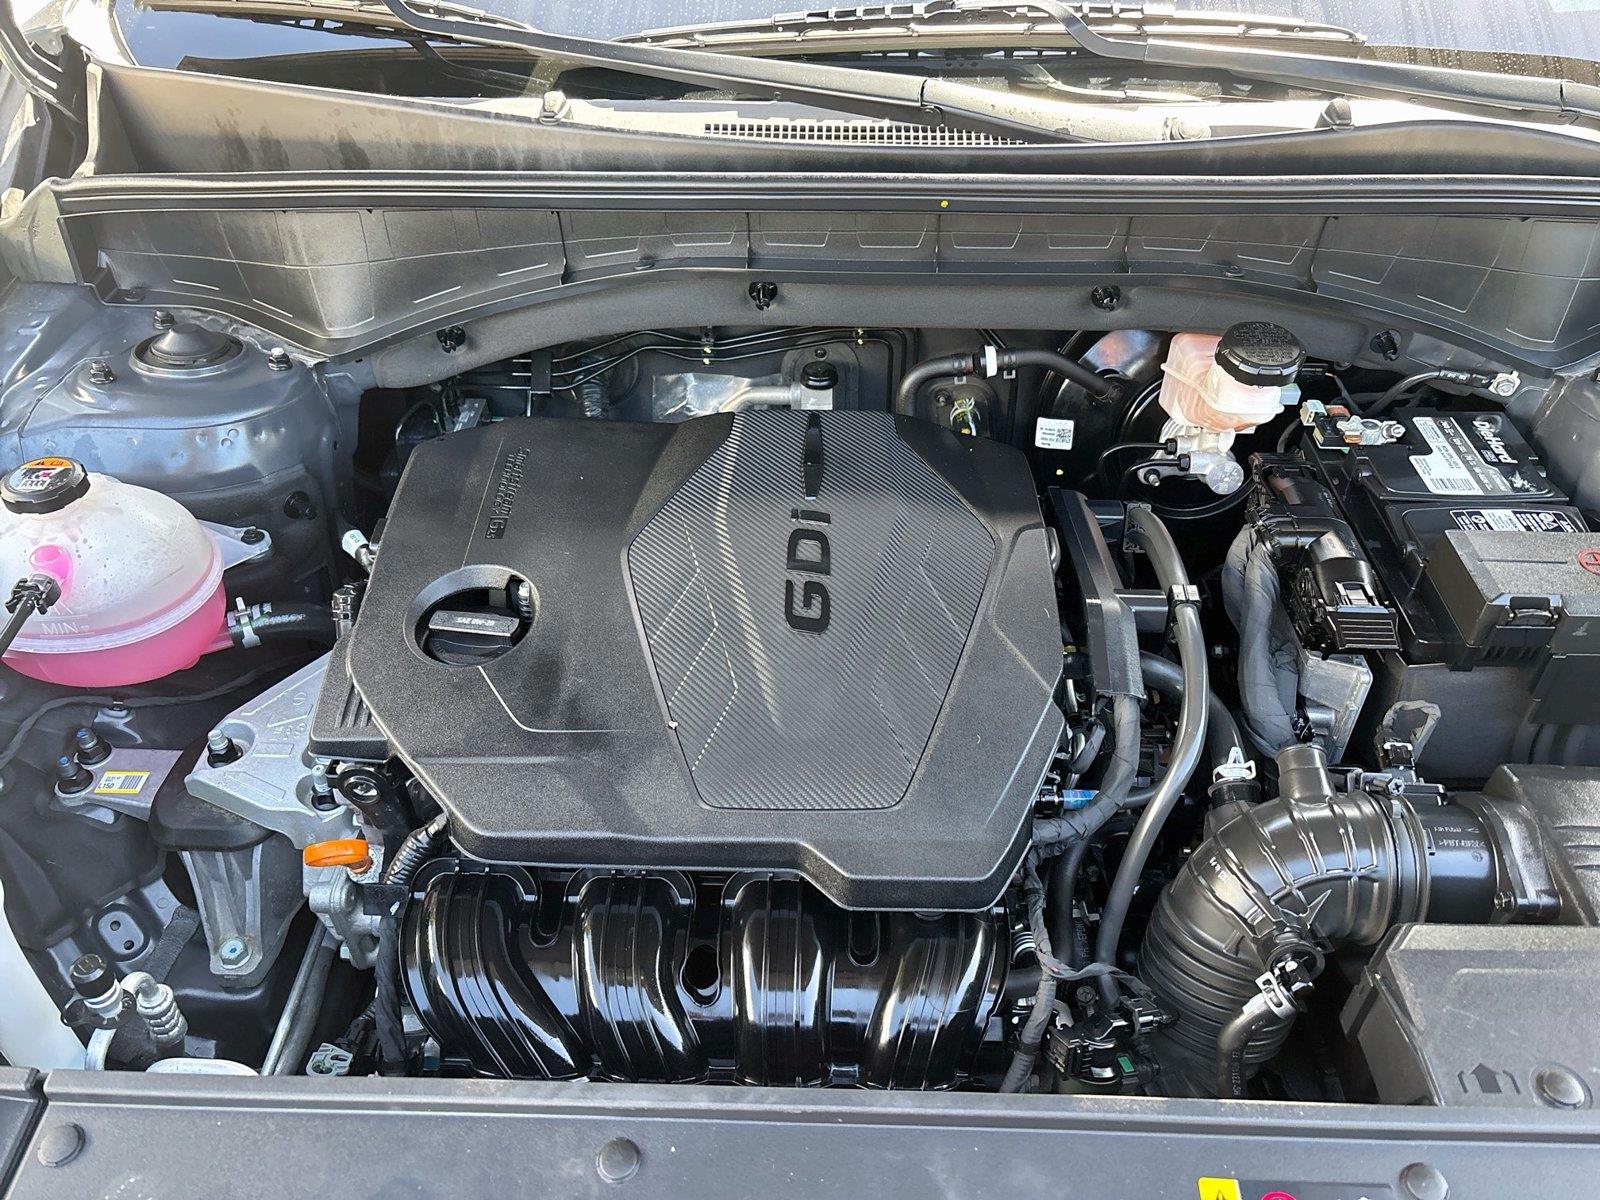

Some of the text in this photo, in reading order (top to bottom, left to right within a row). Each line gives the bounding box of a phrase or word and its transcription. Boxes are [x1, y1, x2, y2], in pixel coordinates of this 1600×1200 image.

[1472, 420, 1518, 463] DieHard
[785, 508, 831, 633] GDi
[41, 621, 79, 635] MIN
[456, 616, 495, 627] SAE 0W-20
